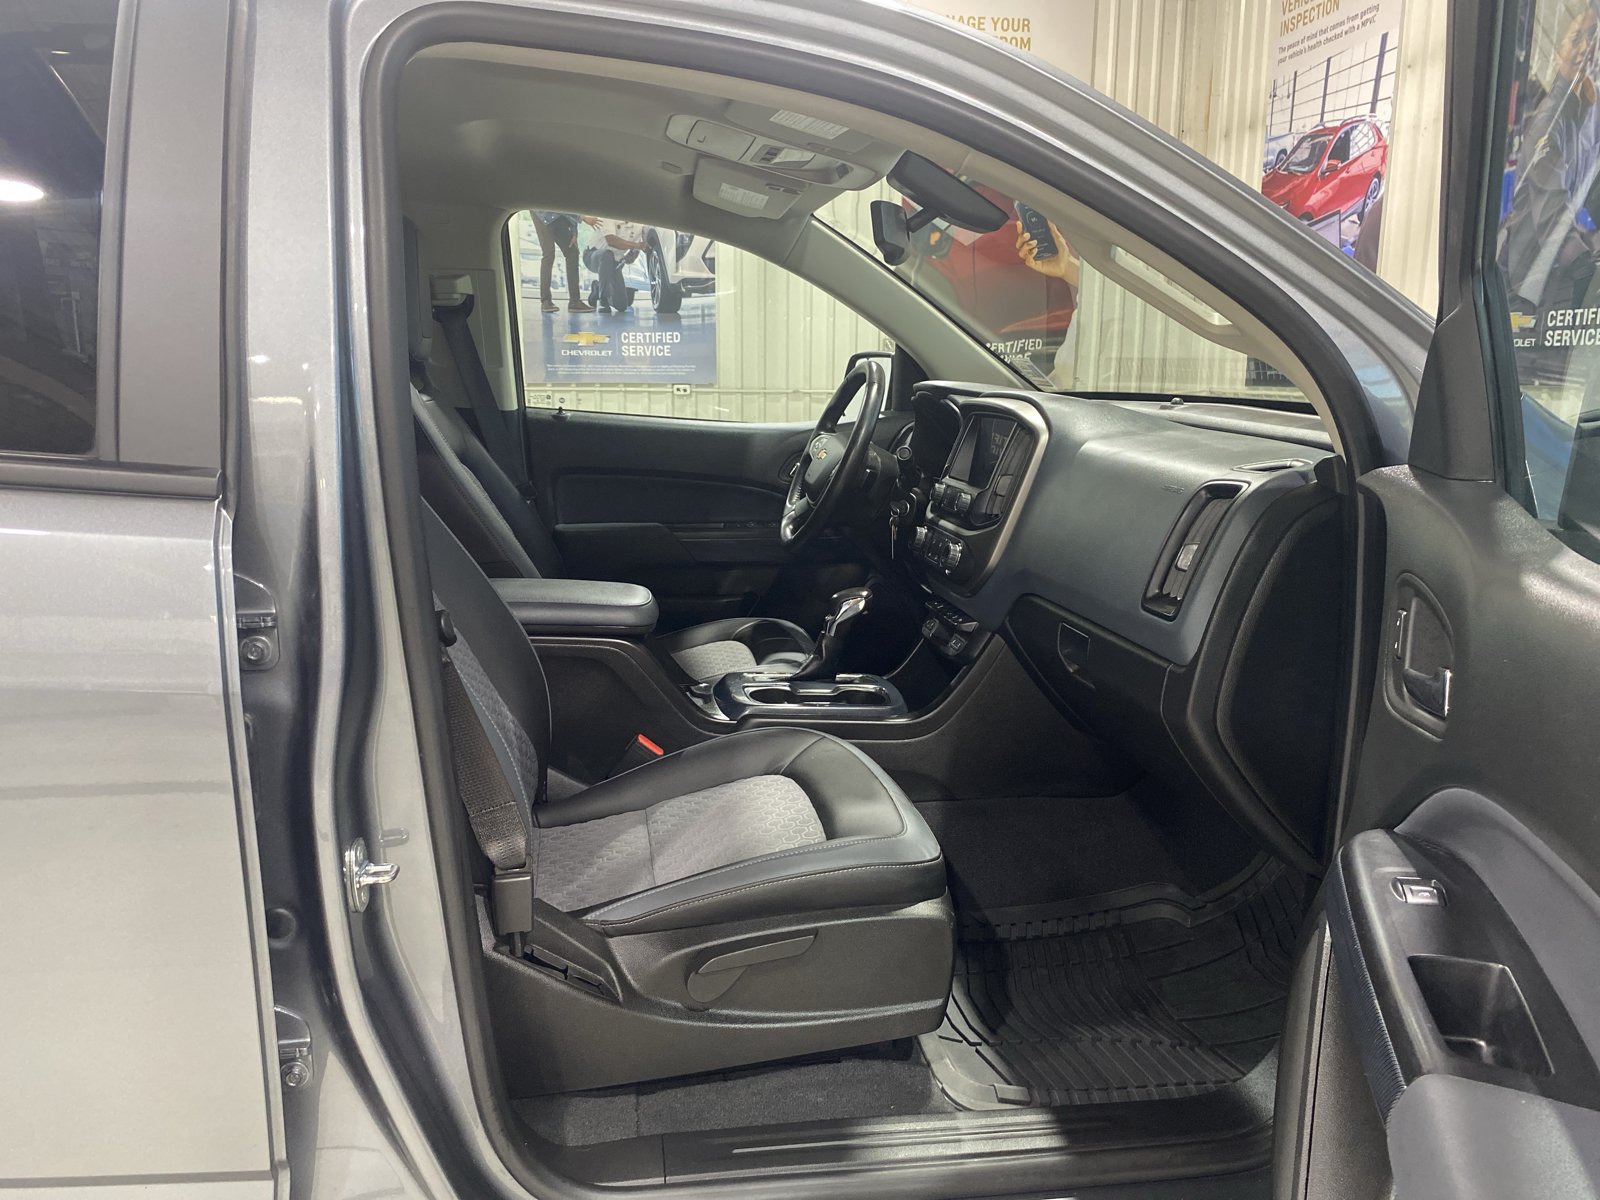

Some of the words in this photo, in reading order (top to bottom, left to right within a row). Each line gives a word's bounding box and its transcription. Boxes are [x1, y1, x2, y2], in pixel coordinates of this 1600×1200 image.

[991, 17, 1031, 33] YOUR
[1280, 0, 1340, 37] INSPECTION
[1306, 30, 1318, 42] mind
[1319, 26, 1329, 37] that
[1330, 19, 1346, 32] comes
[1347, 15, 1359, 24] from
[1360, 3, 1380, 20] getting
[1308, 40, 1322, 51] health
[1323, 30, 1343, 46] checked
[1344, 24, 1356, 36] with
[621, 331, 681, 344] CERTIFIED
[1544, 328, 1600, 347] SERVICE
[561, 349, 613, 357] CHEVROLET
[621, 345, 672, 357] SERVICE
